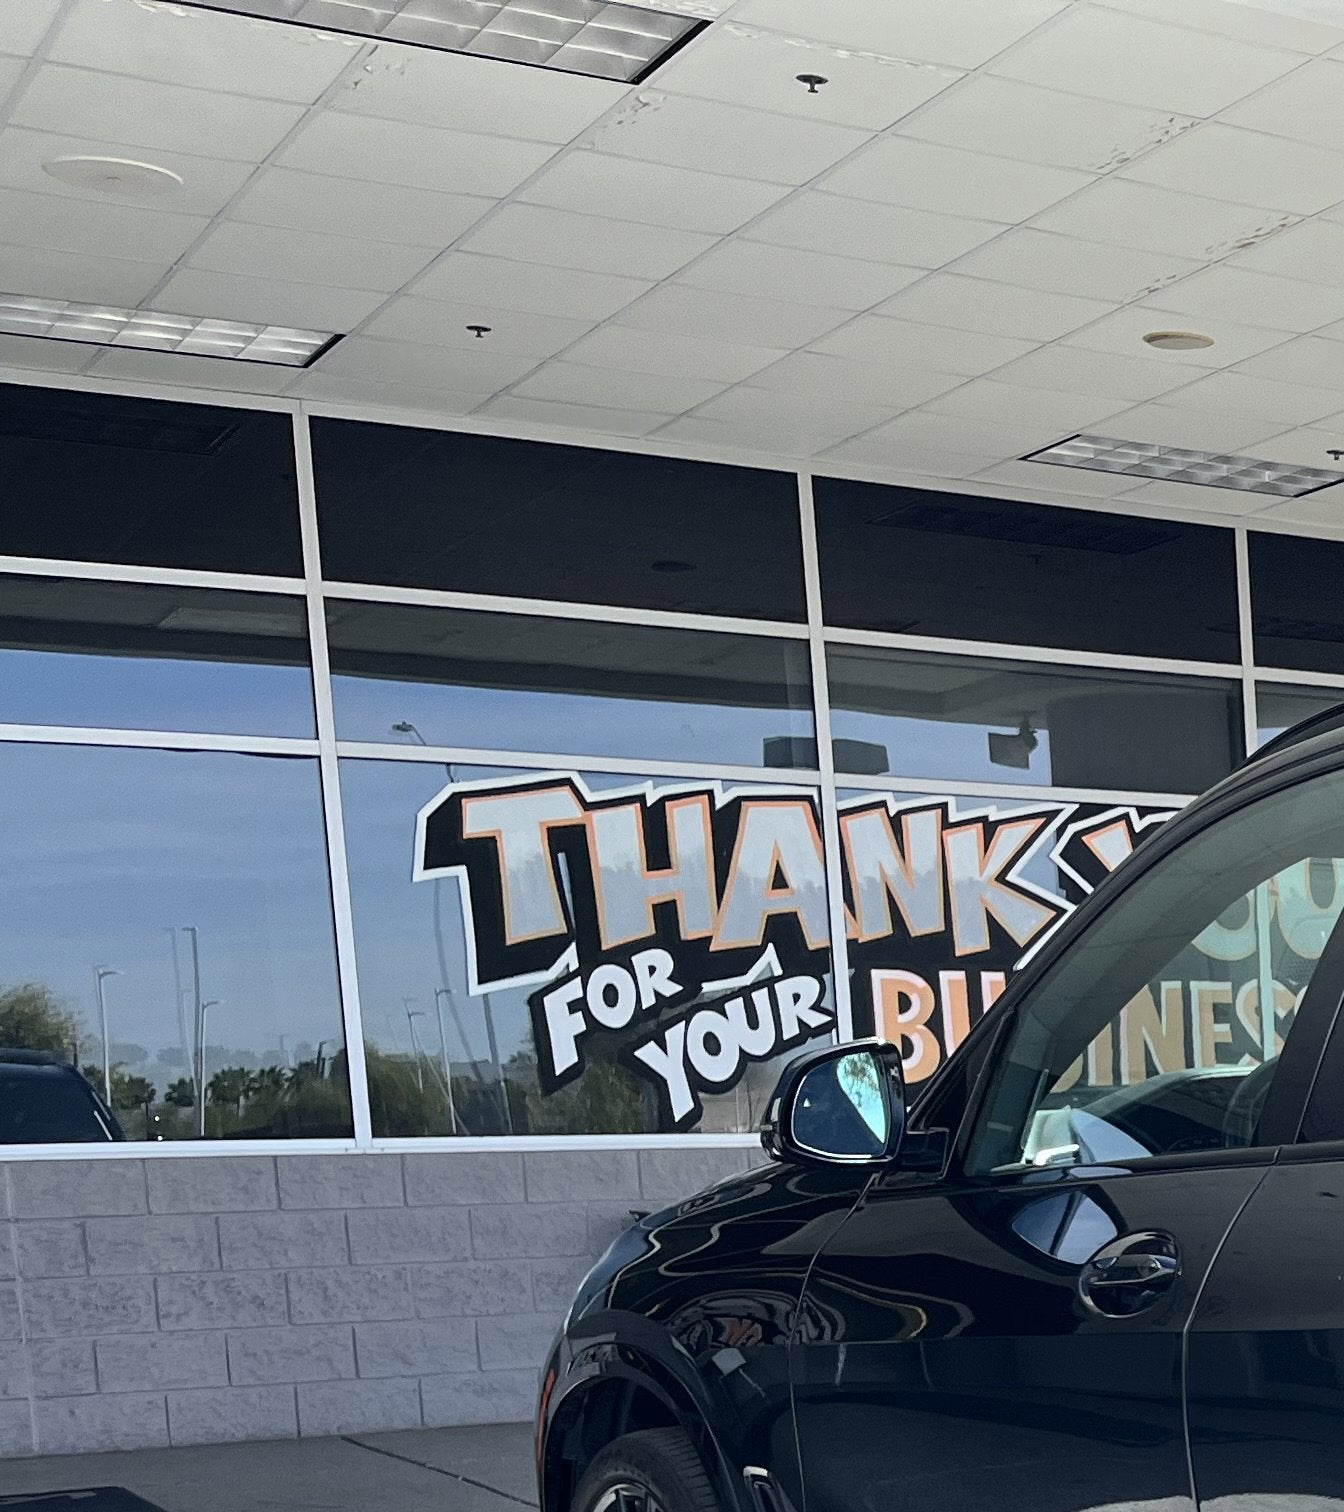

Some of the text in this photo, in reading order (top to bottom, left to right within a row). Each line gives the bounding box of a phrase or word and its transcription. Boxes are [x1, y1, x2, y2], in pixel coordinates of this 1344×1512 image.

[462, 784, 1057, 957] THANK
[543, 948, 684, 1076] FOR
[633, 975, 833, 1123] YOUR
